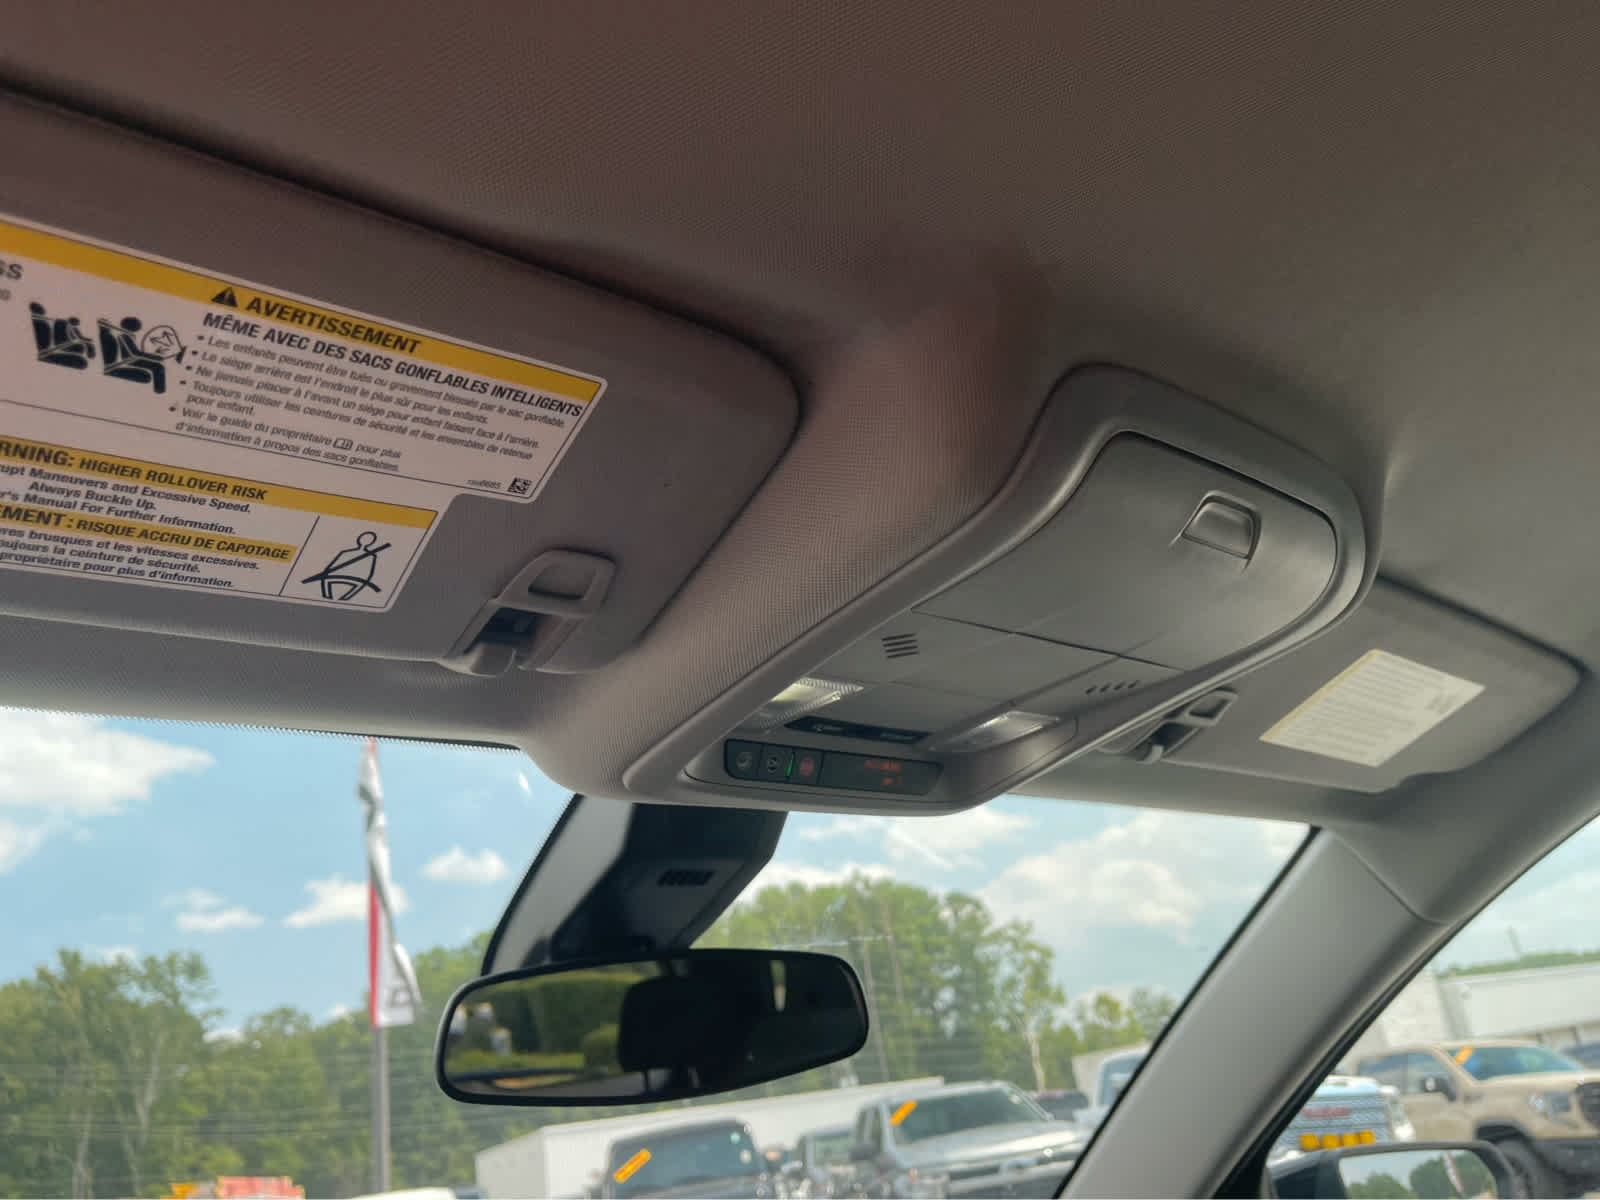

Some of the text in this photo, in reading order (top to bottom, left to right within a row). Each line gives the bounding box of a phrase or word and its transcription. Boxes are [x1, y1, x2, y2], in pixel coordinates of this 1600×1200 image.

[246, 297, 421, 354] AVERTISSEMENT
[202, 352, 217, 362] Le
[294, 372, 312, 385] est
[314, 376, 358, 394] l'endroit
[371, 391, 393, 403] plus
[412, 401, 436, 413] pour
[203, 312, 583, 417] MÊME AVEC DES SACS GONFLABLES INTELLIGENTS
[208, 335, 230, 349] Les
[233, 342, 276, 360] enfants
[278, 354, 325, 373] peuvent
[326, 362, 348, 377] être
[374, 376, 387, 387] ou
[389, 379, 443, 400] gravement
[480, 401, 496, 412] par
[507, 408, 524, 418] sac
[186, 394, 255, 416] pour enfant.
[193, 380, 242, 399] Toujours
[244, 392, 282, 407] utiliser
[284, 400, 301, 412] les
[303, 405, 351, 423] ceintures
[353, 416, 367, 426] de
[368, 419, 409, 435] sécurité
[409, 428, 420, 437] et
[421, 430, 435, 441] les
[486, 443, 499, 453] de
[499, 446, 533, 460] retenue
[195, 366, 213, 377] Ne
[214, 370, 254, 386] jamais
[256, 379, 292, 394] placer
[304, 391, 341, 407] l'avant
[342, 400, 356, 410] un
[358, 402, 385, 416] siège
[386, 408, 410, 421] pour
[411, 414, 442, 428] enfant
[443, 420, 475, 435] faisant
[475, 426, 496, 439] face
[176, 422, 251, 443] d'information
[263, 439, 301, 453] propos
[302, 446, 321, 457] des
[322, 450, 348, 462] sacs
[182, 407, 205, 419] Voir
[219, 416, 251, 429] guide
[254, 423, 269, 433] du
[270, 426, 332, 445] propriétaire
[356, 443, 380, 455] pour
[380, 447, 402, 459] plus
[0, 464, 251, 513] upt Maneuvers and Excessive Speed.
[29, 481, 157, 511] Always Buckle Up.
[79, 458, 142, 479] HIGHER
[145, 469, 228, 493] ROLLOVER
[231, 485, 268, 500] RISK
[0, 504, 67, 527] MENT
[76, 520, 137, 537] RISQUE
[136, 529, 192, 546] ACCRU
[193, 537, 215, 549] DE
[216, 541, 291, 560] CAPOTAGE
[23, 493, 77, 509] Manual
[80, 502, 104, 513] For
[106, 506, 156, 522] Further
[159, 514, 236, 535] Information.
[0, 552, 234, 588] propriétaire pour plus d'information.
[28, 530, 94, 547] brusques
[96, 541, 111, 549] et
[113, 542, 133, 552] les
[136, 546, 189, 561] vitesses
[191, 555, 259, 570] excessives.
[53, 546, 65, 555] la
[69, 548, 125, 563] ceinture
[128, 556, 145, 565] de
[146, 558, 201, 573] sécurité.
